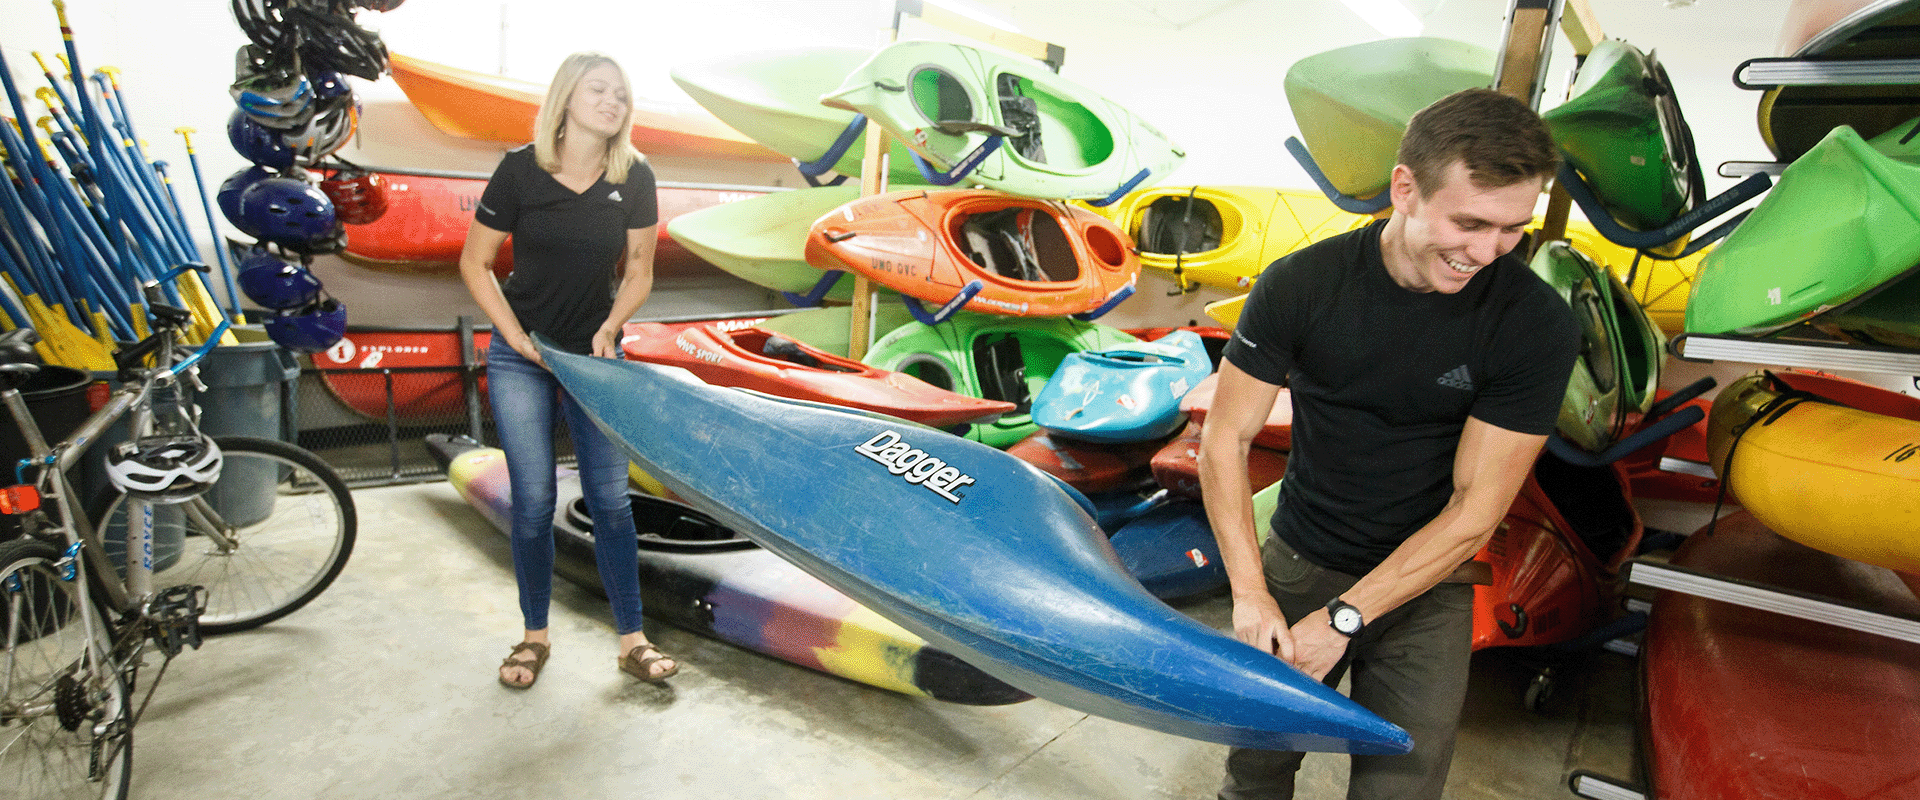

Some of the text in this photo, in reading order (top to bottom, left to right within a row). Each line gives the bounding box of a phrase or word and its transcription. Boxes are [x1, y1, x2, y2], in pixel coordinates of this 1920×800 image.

[676, 334, 724, 364] WAVE SPORT
[854, 429, 977, 505] Dagger
[143, 505, 152, 570] ROYCE
